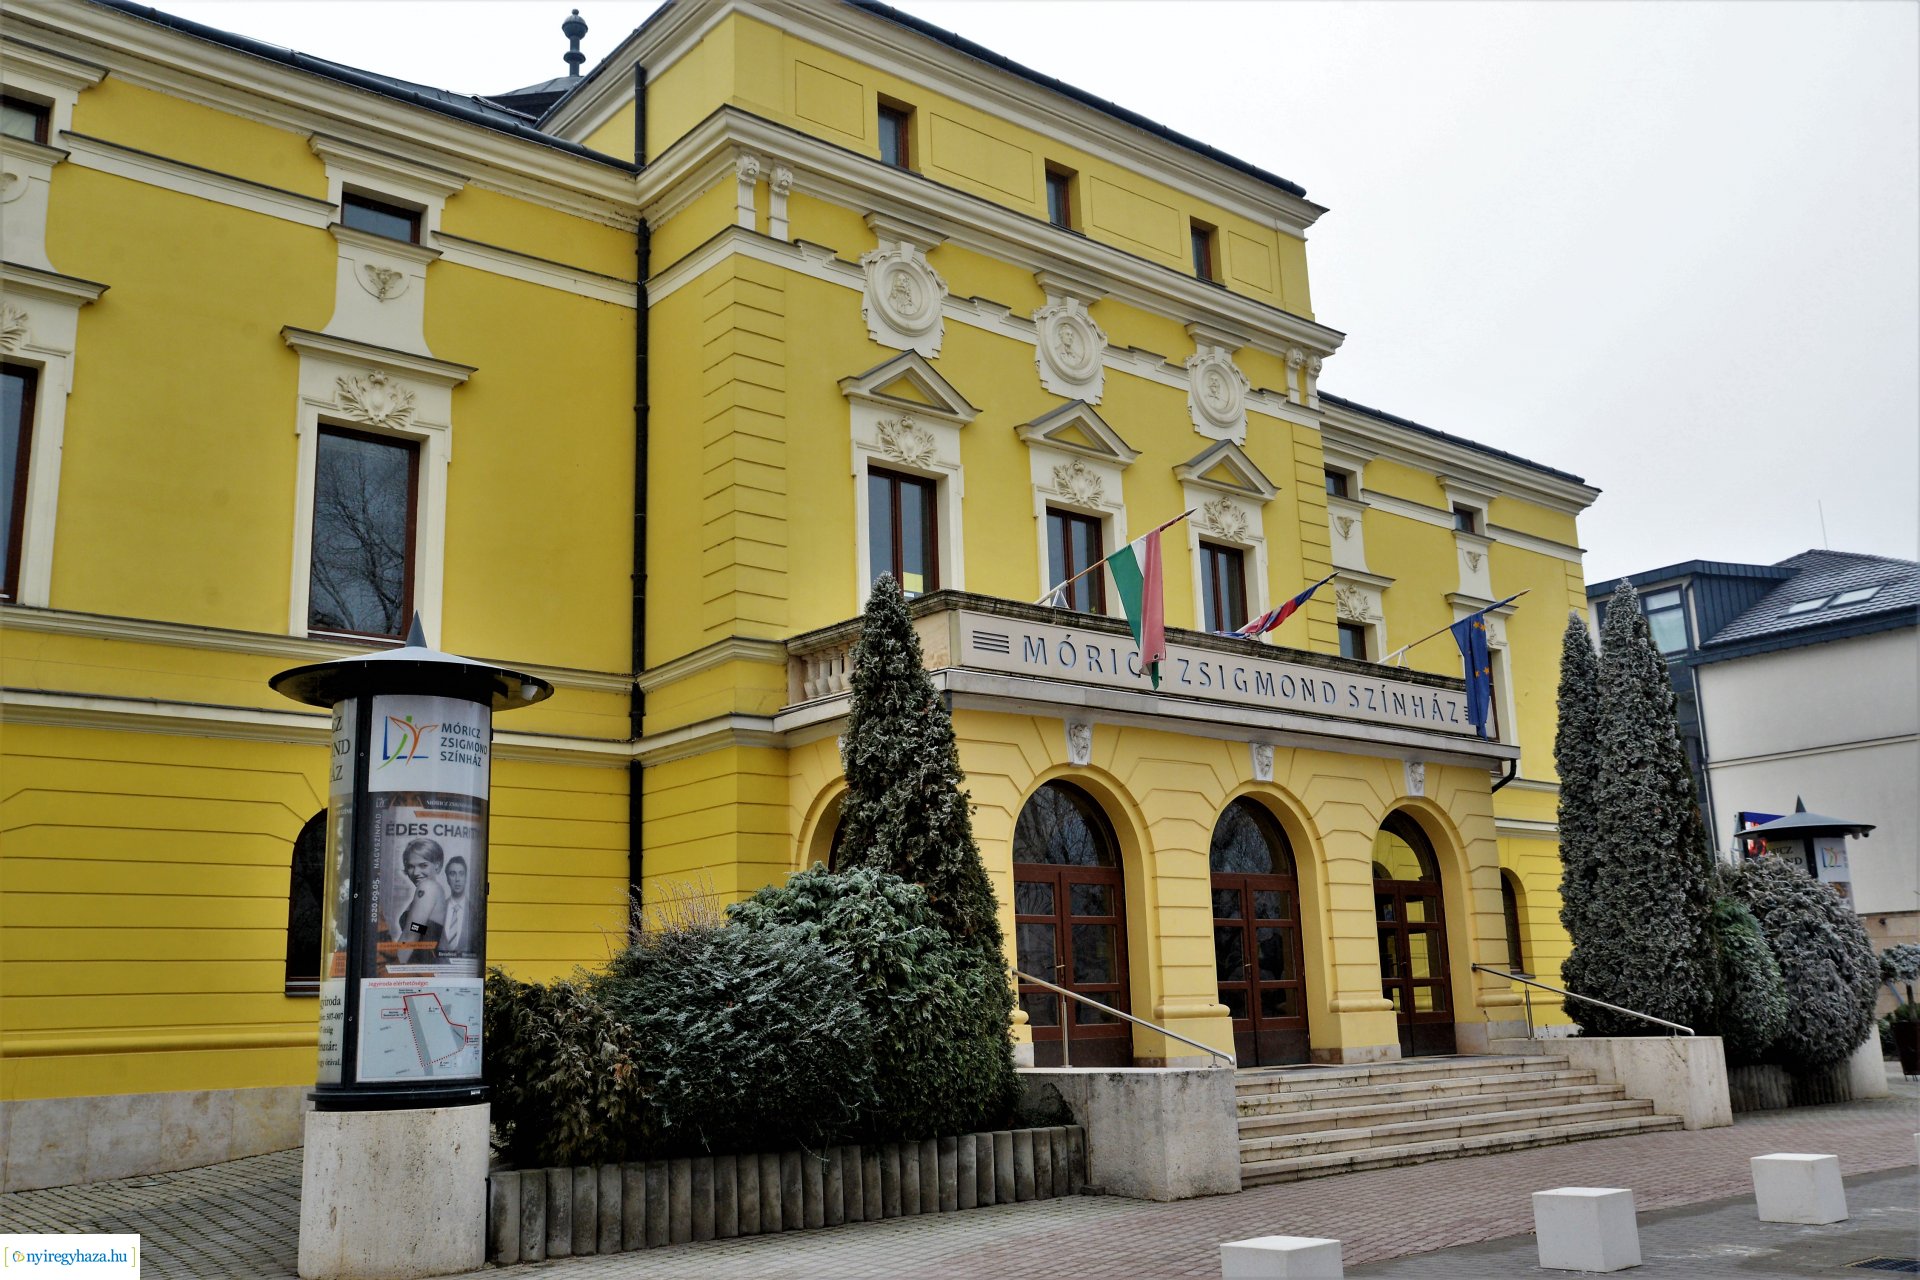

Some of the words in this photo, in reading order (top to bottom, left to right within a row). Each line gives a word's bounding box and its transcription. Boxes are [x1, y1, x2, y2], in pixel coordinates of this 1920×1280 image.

[1023, 633, 1162, 682] MÓRIC
[1177, 657, 1337, 705] ZSIGMOND
[1349, 683, 1460, 725] SZÍNHÁZ
[441, 722, 481, 739] MÓRICZ
[440, 736, 488, 755] ZSIGMOND
[440, 750, 482, 767] SZÍNHÁZ
[385, 820, 429, 837] ÉDES
